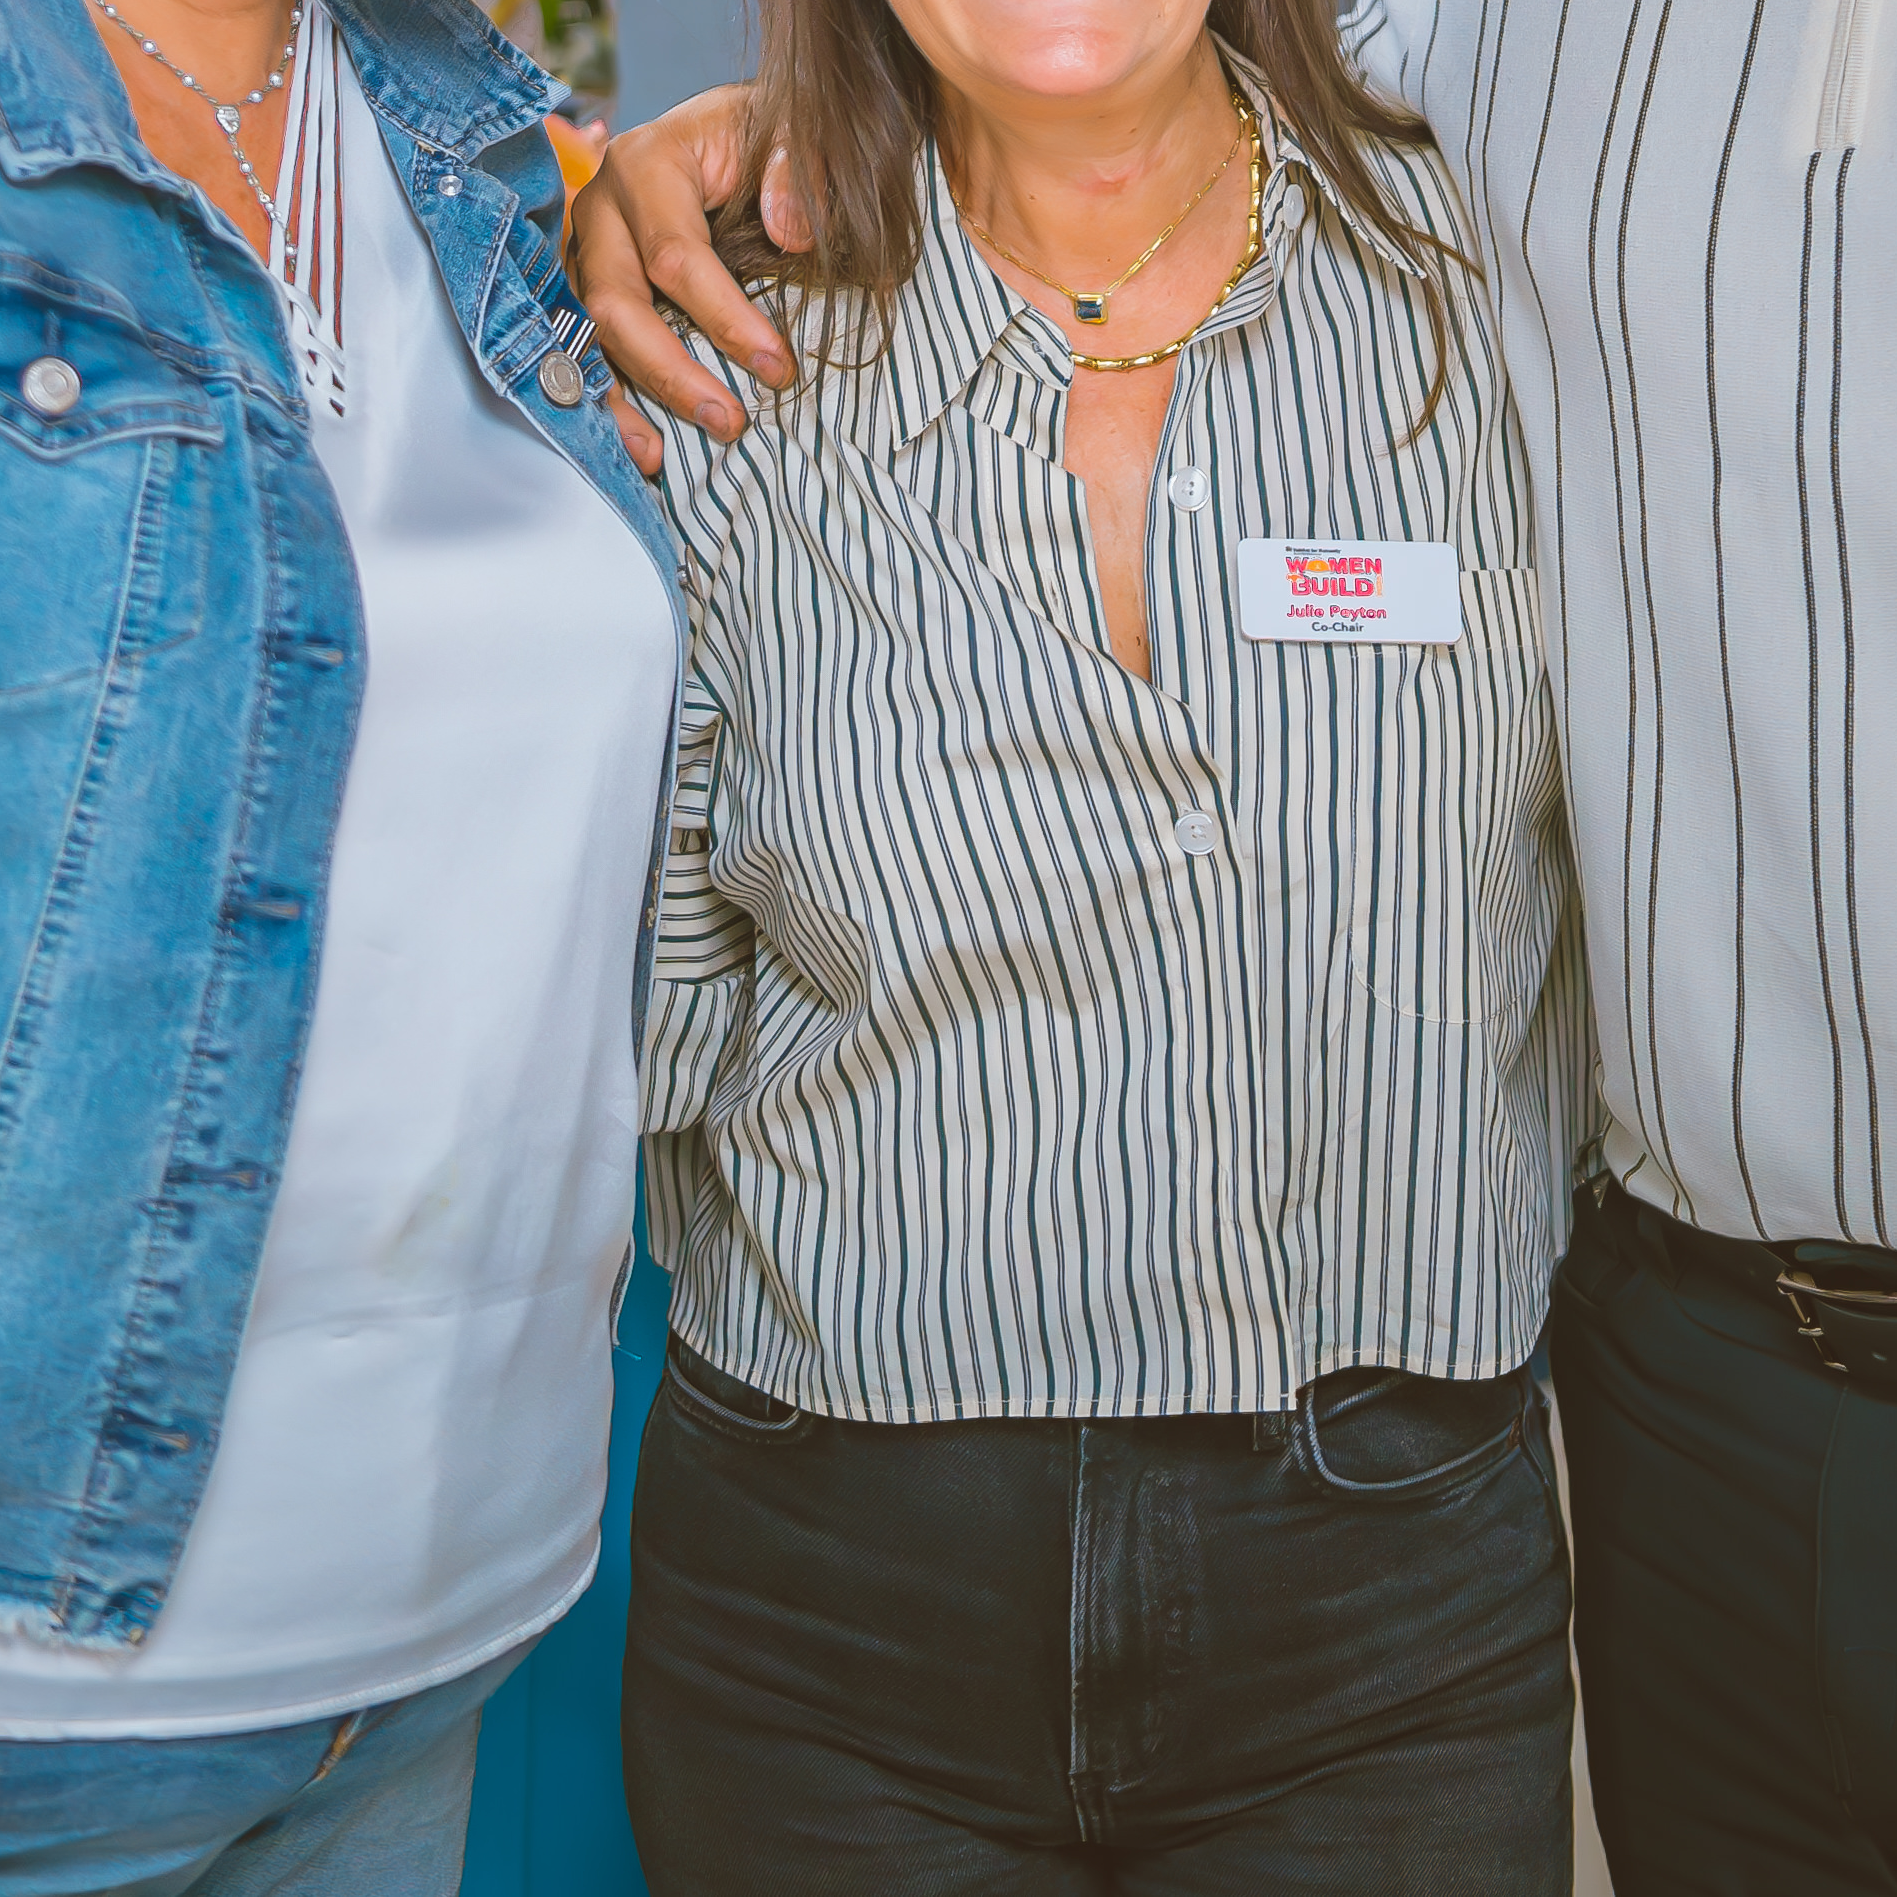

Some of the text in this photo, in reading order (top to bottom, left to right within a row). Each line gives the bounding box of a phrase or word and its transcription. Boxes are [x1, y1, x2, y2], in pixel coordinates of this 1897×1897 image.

[1290, 575, 1375, 597] BUILD
[1287, 604, 1387, 622] Julie Peyton
[1311, 621, 1365, 632] Co-Chair
